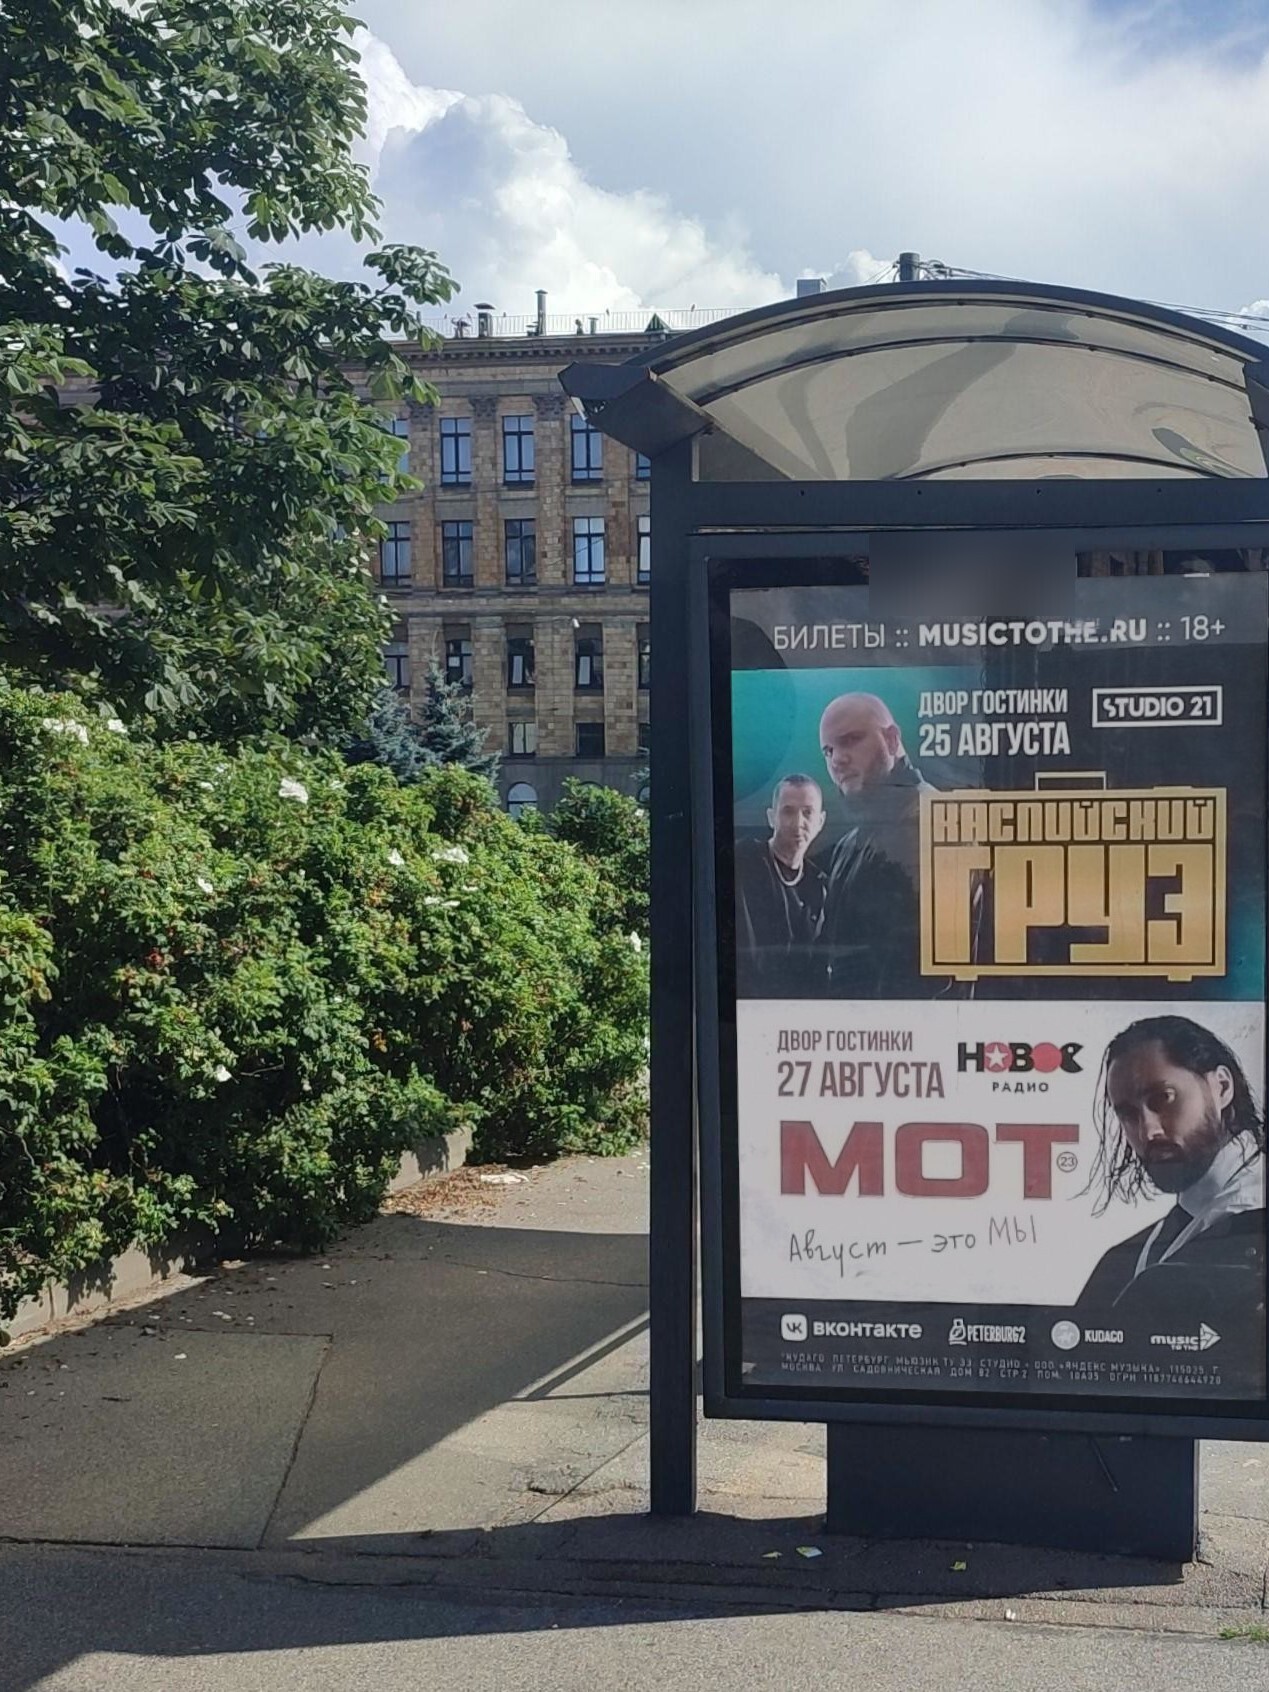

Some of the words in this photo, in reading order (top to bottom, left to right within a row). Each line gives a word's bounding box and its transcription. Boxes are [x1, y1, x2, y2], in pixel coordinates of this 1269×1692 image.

[774, 624, 885, 650] БИЛЕТЫ
[919, 618, 1147, 647] MUSICTOTHE.RU
[1180, 615, 1226, 641] 18+
[918, 690, 967, 718] ДВОР
[971, 688, 1068, 715] ГОСТИНКИ
[1103, 698, 1185, 718] STUDIO
[1189, 696, 1212, 716] 21
[919, 723, 951, 757] 25
[957, 721, 1071, 756] АВГУСТА
[932, 798, 1215, 842] КАСПИЙСКИЙ
[933, 844, 1214, 964] ГРУЗ
[777, 1030, 822, 1053] ДВОР
[826, 1030, 914, 1052] ГОСТИНКИ
[777, 1060, 813, 1098] 27
[819, 1061, 945, 1099] АВГУСТА
[992, 1082, 1050, 1094] РАДИО
[779, 1120, 1080, 1200] МОТ
[789, 1229, 888, 1278] Август
[931, 1234, 977, 1252] это
[989, 1215, 1037, 1246] МЫ
